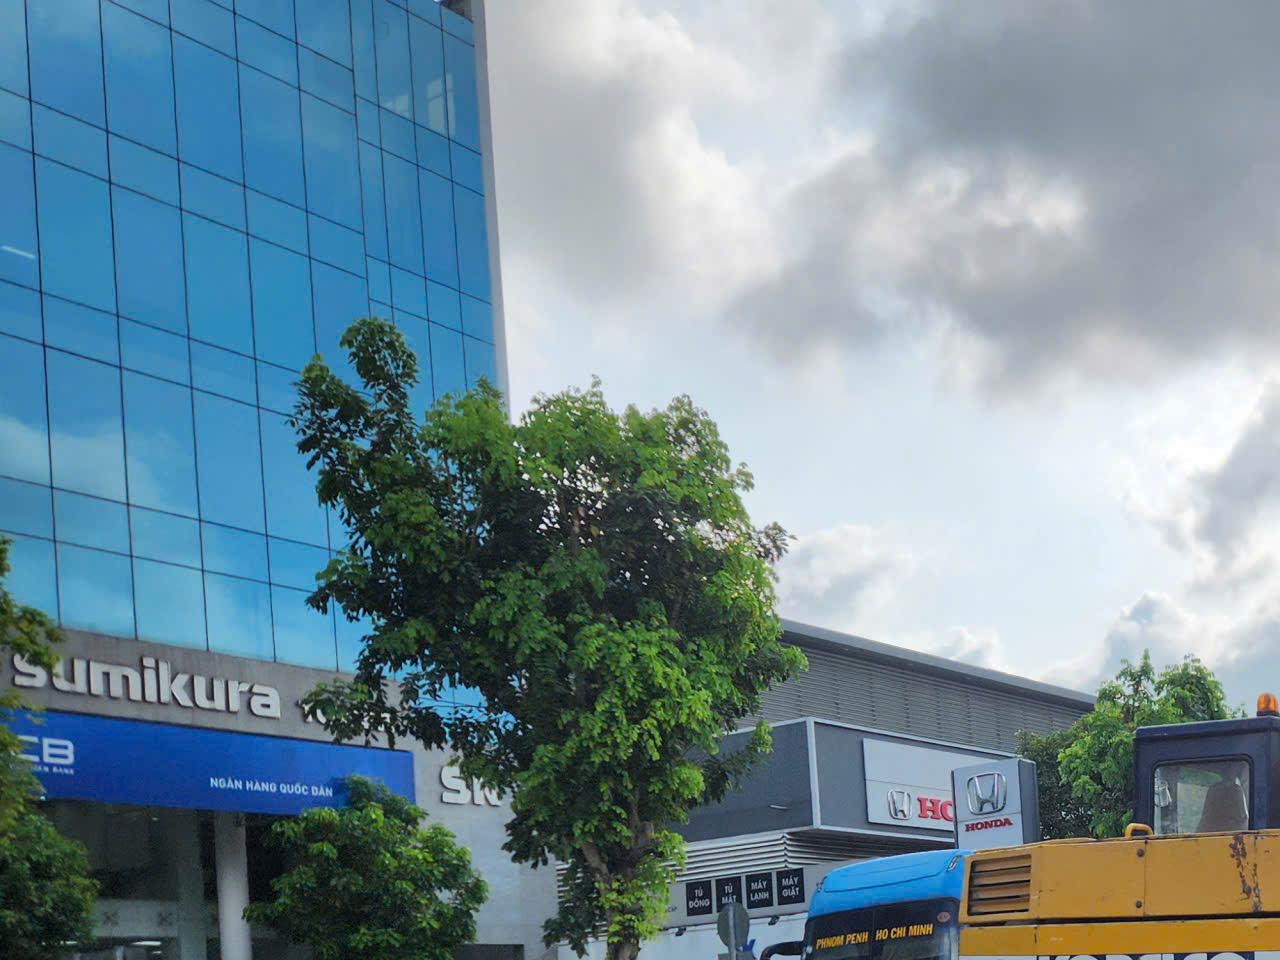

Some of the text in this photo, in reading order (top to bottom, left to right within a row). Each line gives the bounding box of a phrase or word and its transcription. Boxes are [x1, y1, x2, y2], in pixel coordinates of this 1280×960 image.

[13, 653, 281, 719] sumikura
[965, 818, 1013, 832] HONDA
[751, 879, 767, 890] MÁY
[782, 875, 798, 886] MÁY
[750, 891, 769, 902] LẠNH
[816, 923, 933, 949] PHNOM PENH HO CHI MINH
